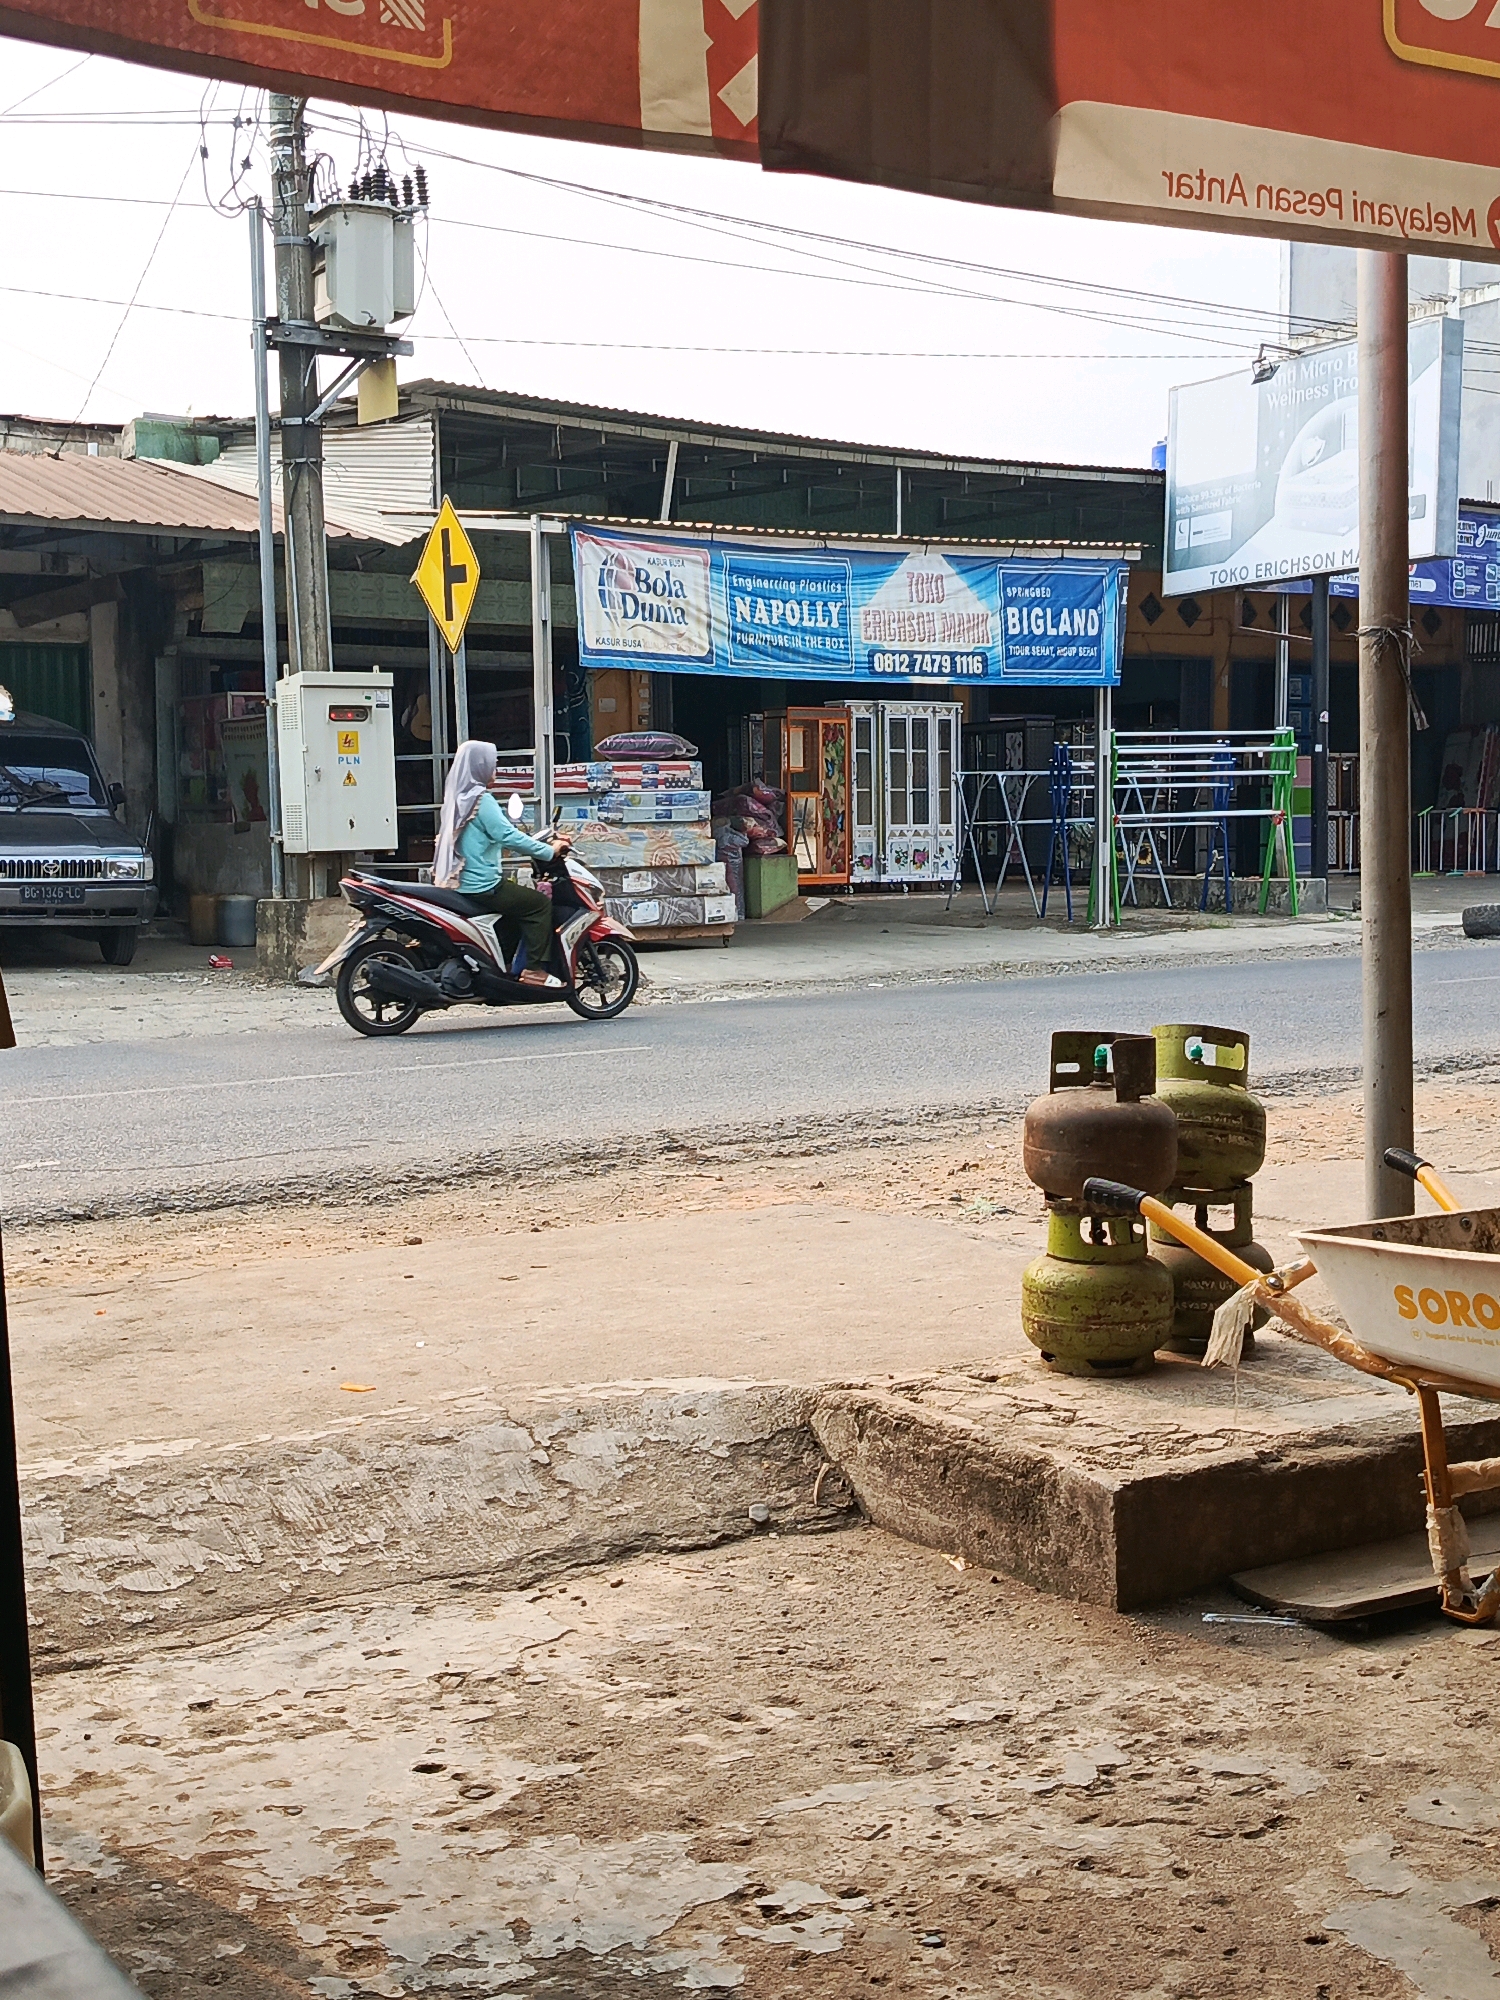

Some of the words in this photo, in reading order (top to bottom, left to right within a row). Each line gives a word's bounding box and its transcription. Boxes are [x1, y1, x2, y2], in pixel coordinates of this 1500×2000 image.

[1300, 358, 1344, 382] Micro
[1265, 383, 1330, 412] Wellness
[1209, 565, 1249, 586] TOKO
[1255, 551, 1336, 579] ERICHSON
[634, 567, 688, 599] Bola
[799, 578, 842, 594] Plastics
[906, 571, 946, 604] TOKO
[1006, 586, 1051, 598] SPRINGBED
[619, 591, 689, 626] Dunia
[734, 596, 843, 629] NAPOLLY
[1006, 606, 1100, 637] BIGLAND
[862, 609, 937, 643] ERICHSON
[595, 636, 621, 647] KASUR
[622, 638, 642, 648] BUSA
[735, 632, 790, 648] FURNITURE
[791, 634, 803, 648] IN
[804, 635, 823, 649] THE
[825, 636, 845, 650] BOX
[1008, 645, 1031, 656] TIDUR
[873, 652, 910, 673] 0812
[913, 653, 951, 674] 7479
[955, 655, 983, 674] 1116
[337, 756, 361, 765] PLN
[24, 886, 37, 899] BG
[68, 887, 81, 899] LC
[1393, 1284, 1500, 1331] SORO
